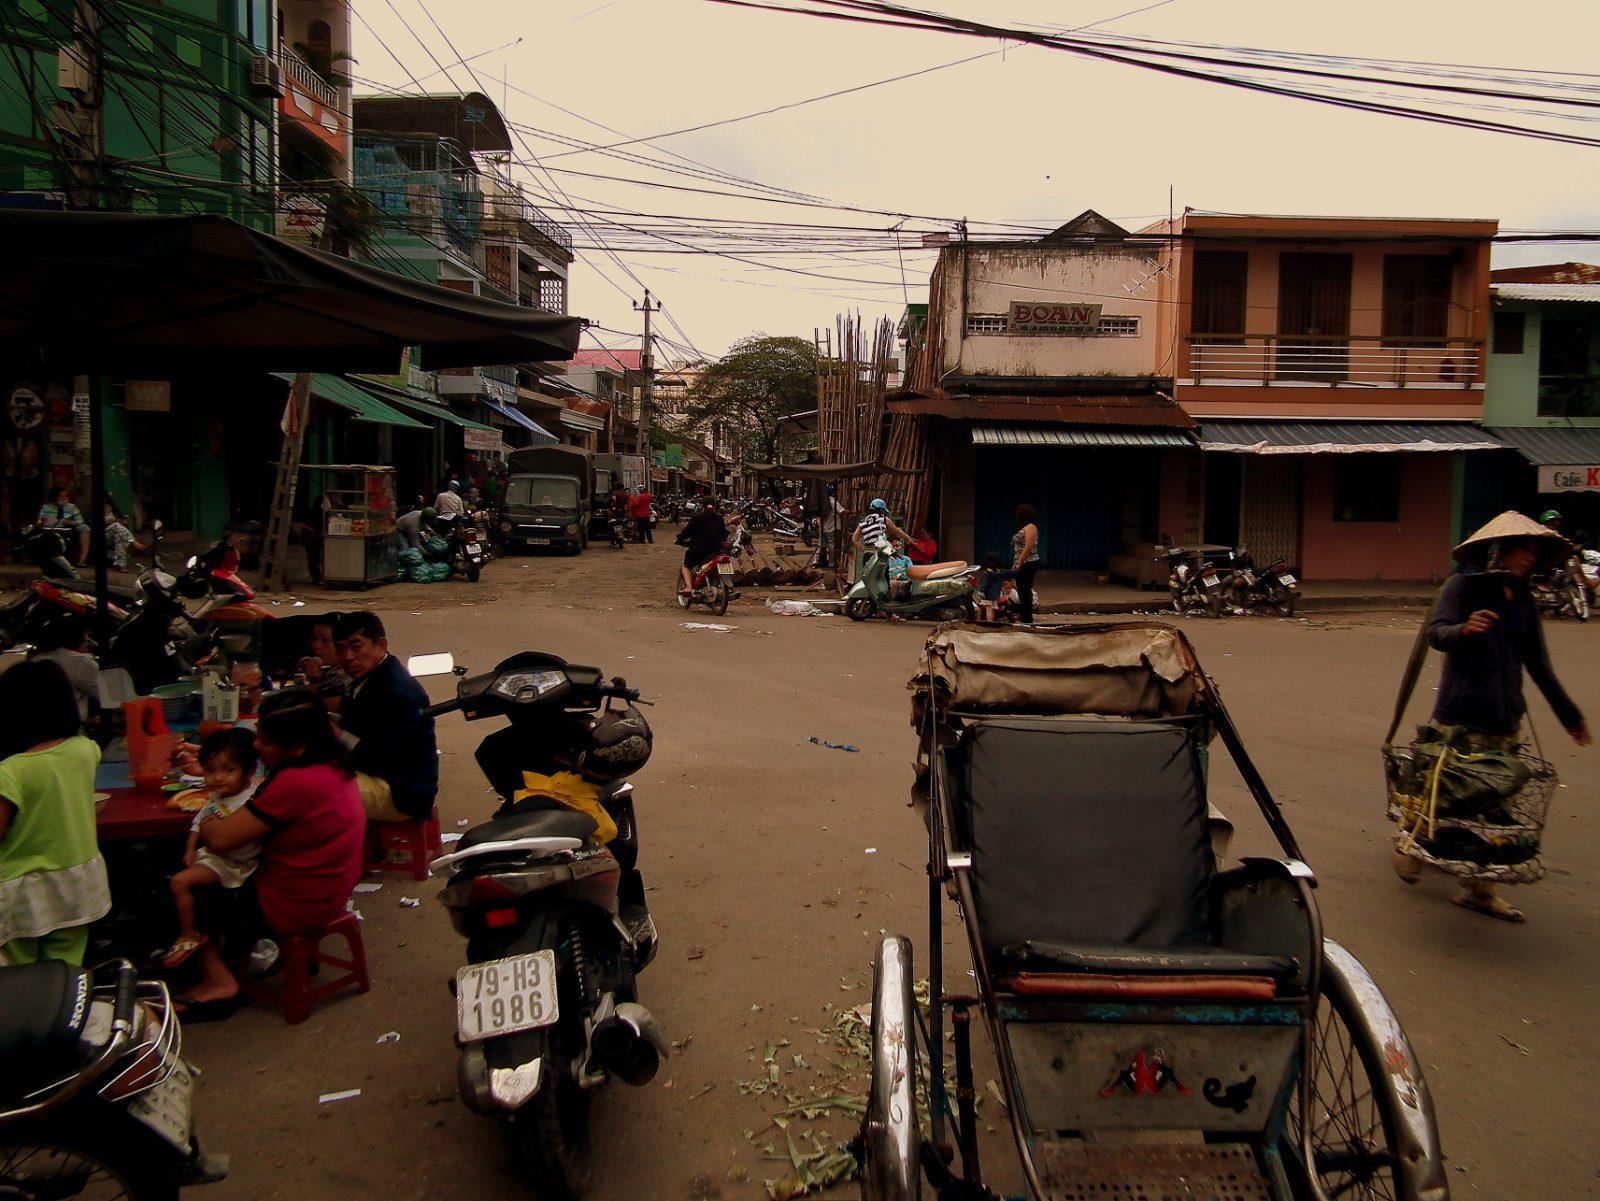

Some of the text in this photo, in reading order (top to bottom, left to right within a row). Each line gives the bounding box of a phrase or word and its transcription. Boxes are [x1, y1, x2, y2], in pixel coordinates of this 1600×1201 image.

[471, 958, 541, 999] 79-H3
[68, 973, 88, 1030] HONDA
[473, 990, 543, 1032] 1986
